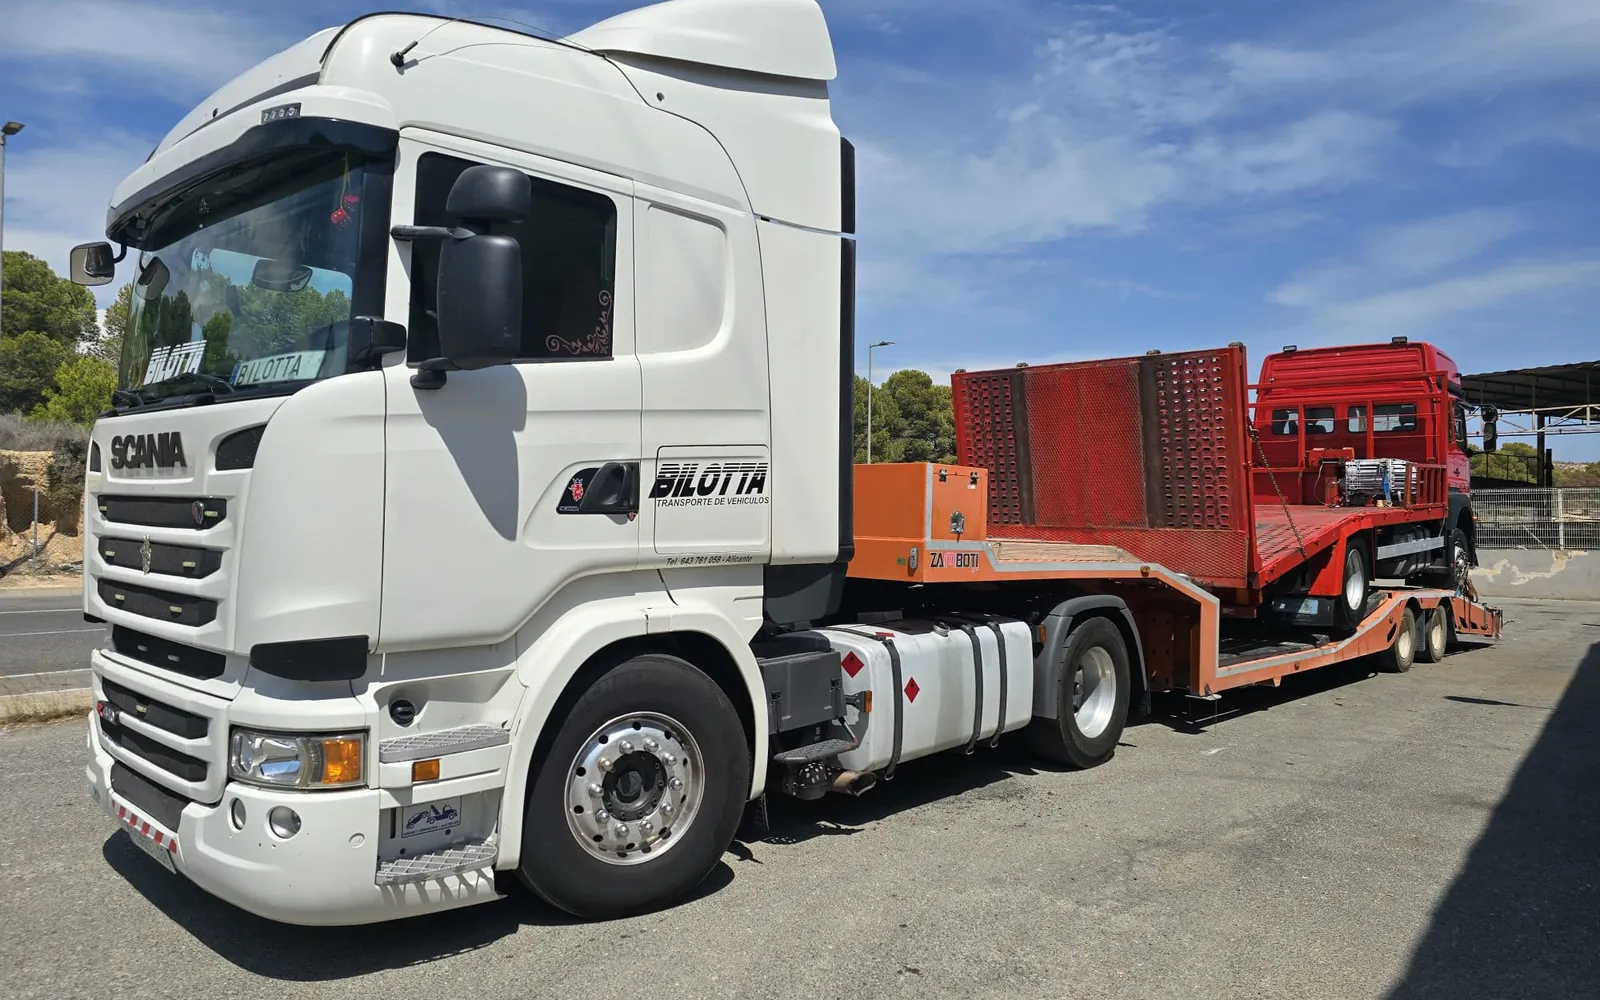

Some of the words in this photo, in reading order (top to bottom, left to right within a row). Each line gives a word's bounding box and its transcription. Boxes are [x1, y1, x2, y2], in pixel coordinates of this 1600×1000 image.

[237, 355, 300, 385] BILOTTA
[111, 432, 187, 469] SCANIA
[648, 463, 768, 498] BILOTTA
[657, 498, 712, 507] TRANSPORTE
[714, 497, 725, 506] DE
[727, 497, 770, 505] VEHICULOS
[680, 556, 693, 565] 643
[694, 556, 708, 564] 761
[708, 555, 722, 564] 058
[725, 554, 753, 563] Alicante
